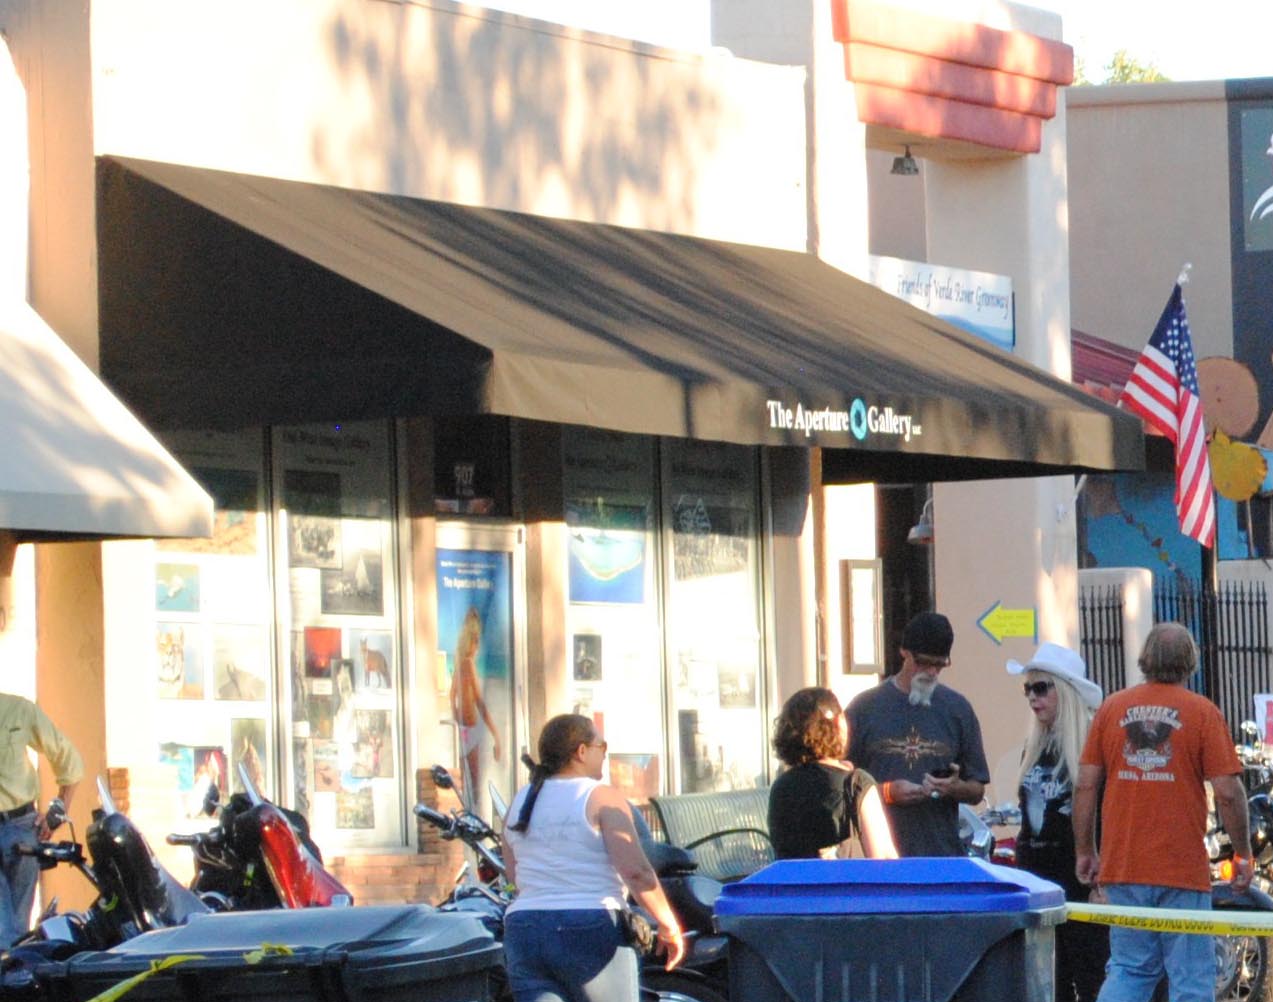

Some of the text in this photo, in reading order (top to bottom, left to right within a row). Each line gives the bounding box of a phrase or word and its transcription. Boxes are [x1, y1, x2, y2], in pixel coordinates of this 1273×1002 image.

[766, 400, 793, 429] The
[794, 402, 850, 438] Aperture
[867, 405, 912, 442] Gallery
